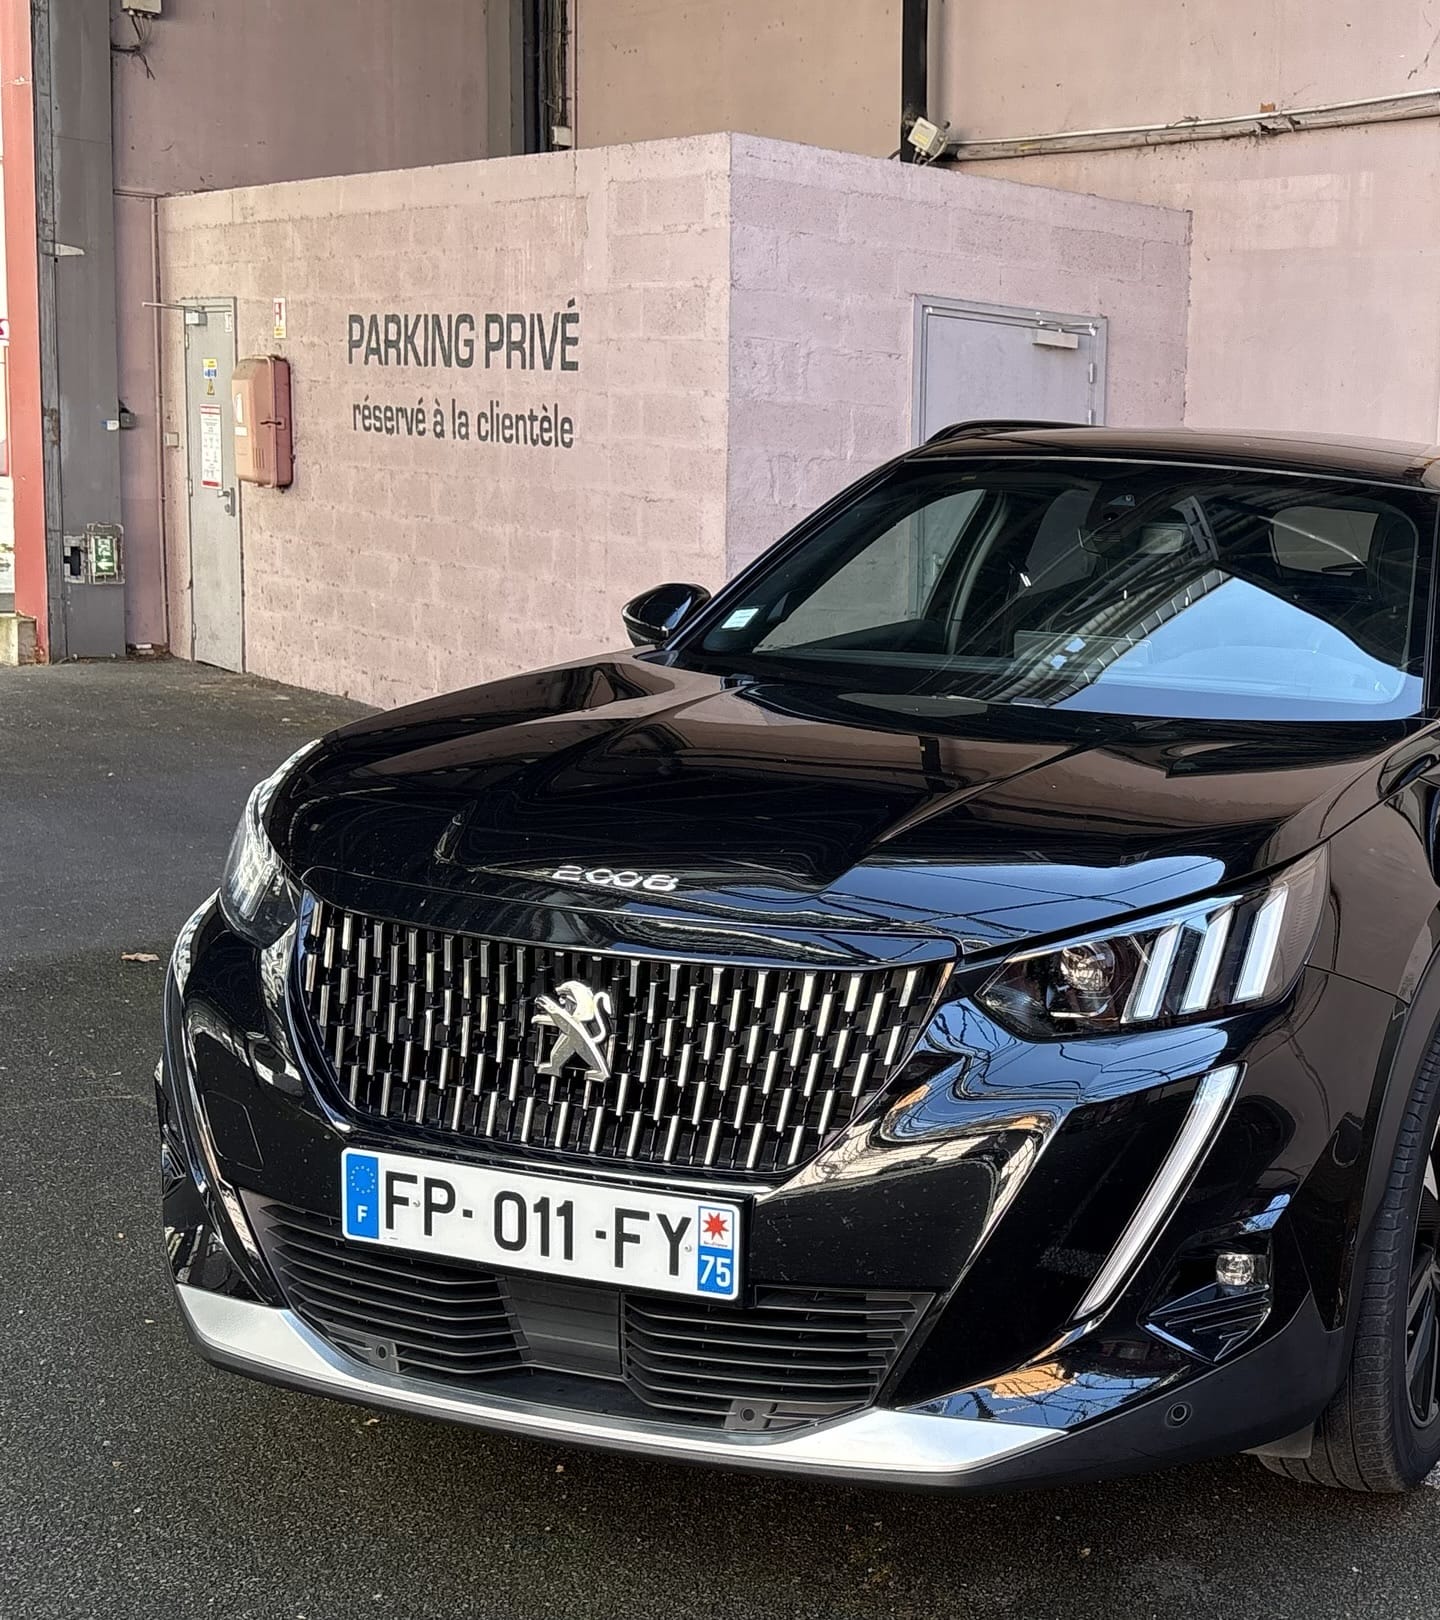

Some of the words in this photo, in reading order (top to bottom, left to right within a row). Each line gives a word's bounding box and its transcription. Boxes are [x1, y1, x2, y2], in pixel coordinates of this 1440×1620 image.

[348, 313, 475, 368] PARKING
[485, 298, 580, 371] PRIVÉ
[353, 394, 426, 437] réservé
[433, 397, 446, 439] à
[452, 398, 470, 441] la
[477, 400, 574, 449] clientèle
[551, 865, 679, 892] 2008
[357, 1204, 368, 1223] F
[700, 1254, 731, 1288] 75
